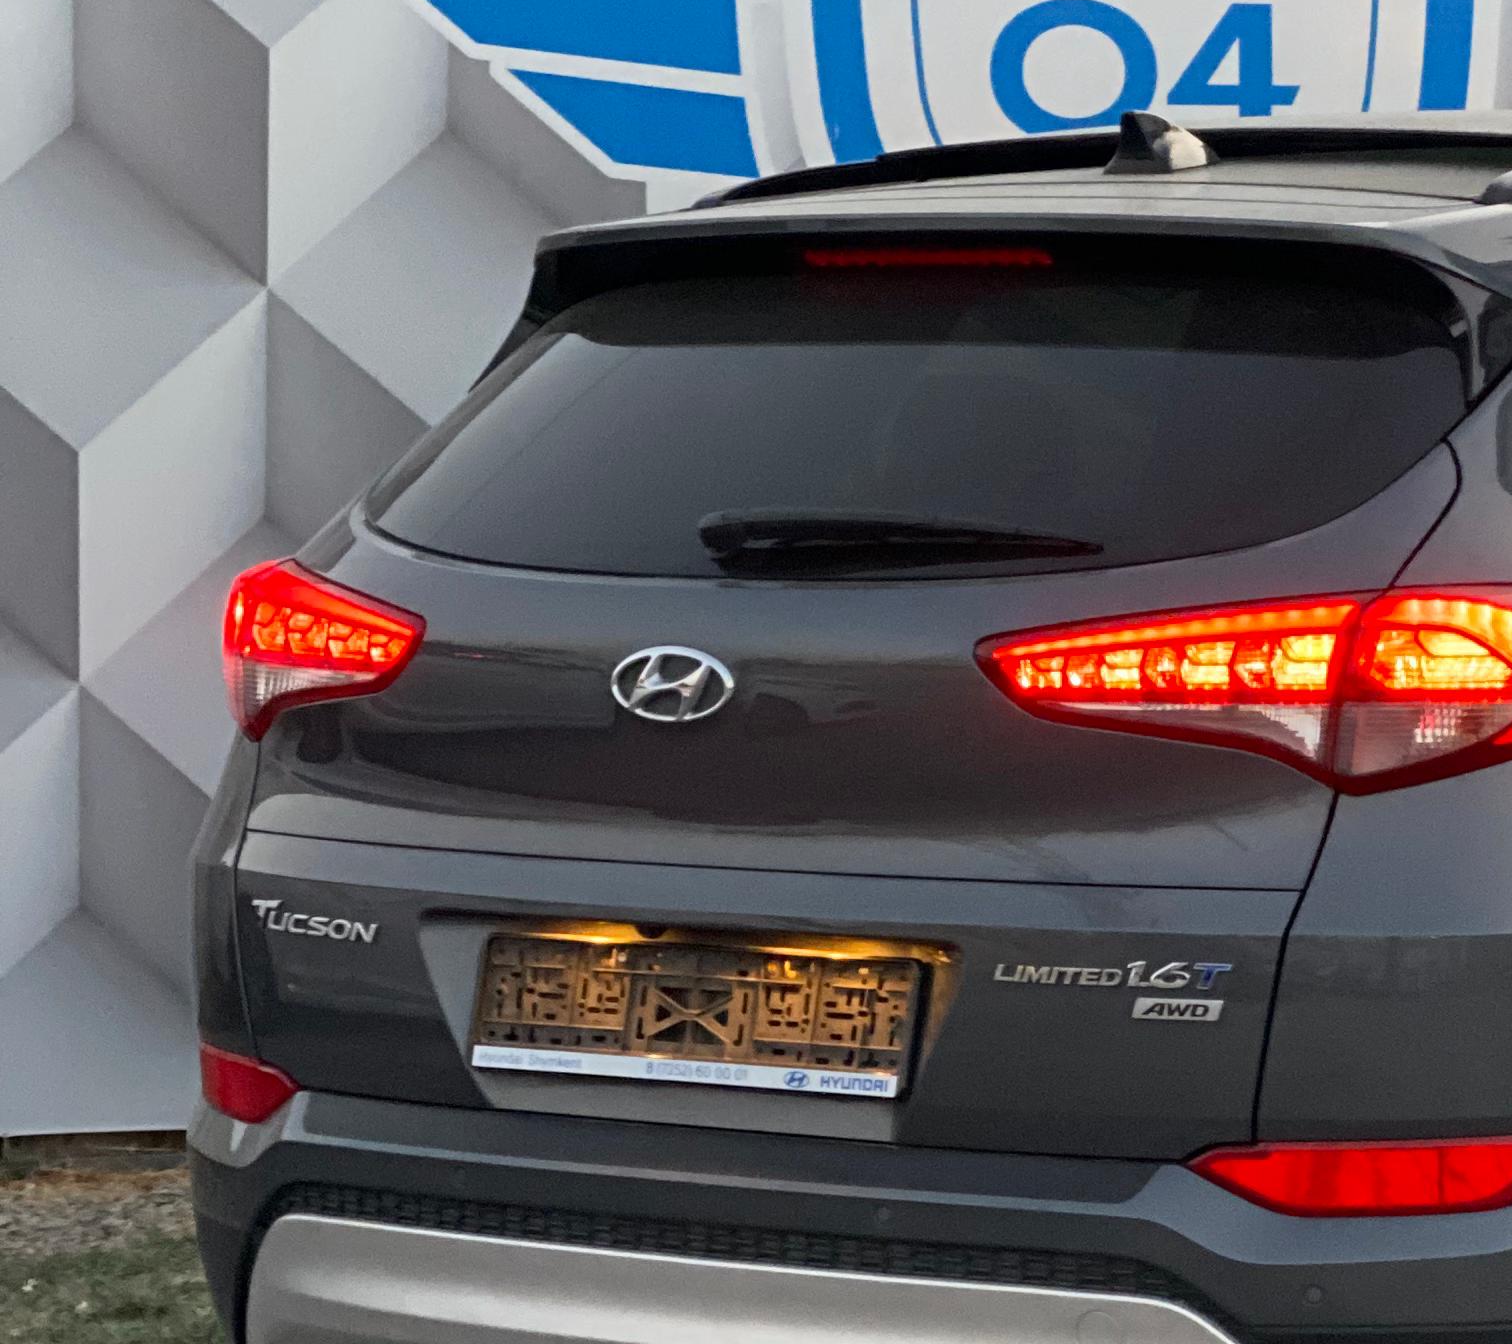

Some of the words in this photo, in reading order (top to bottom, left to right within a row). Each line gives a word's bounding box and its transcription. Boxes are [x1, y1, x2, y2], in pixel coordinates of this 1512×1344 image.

[992, 963, 1123, 987] LIMITED
[1141, 1002, 1210, 1018] AWD
[819, 1075, 889, 1093] HYUNDAI
